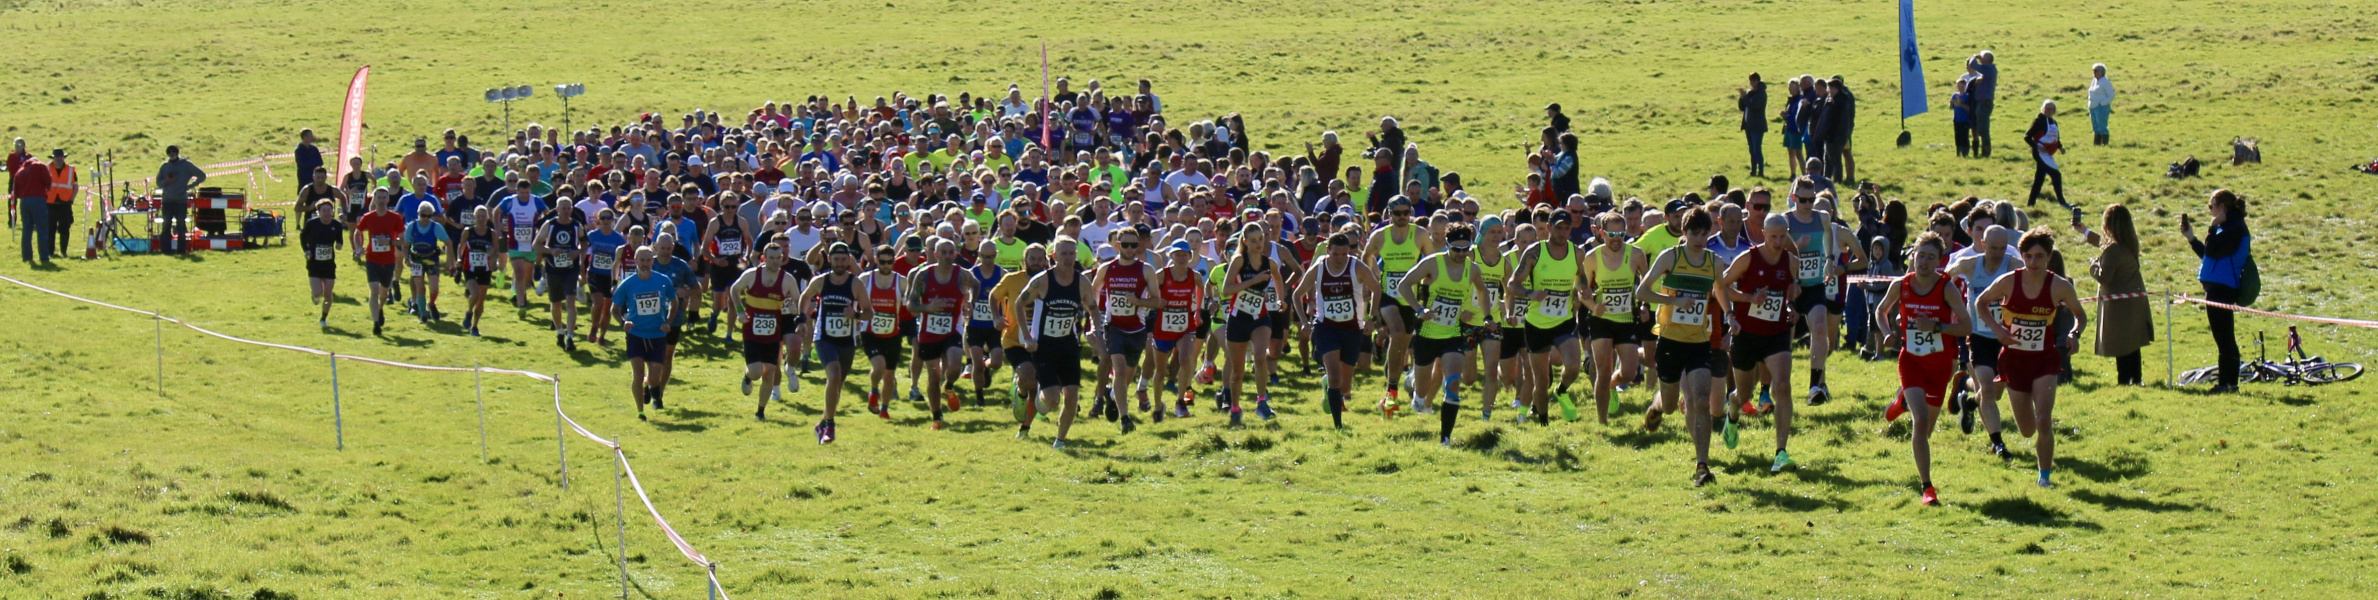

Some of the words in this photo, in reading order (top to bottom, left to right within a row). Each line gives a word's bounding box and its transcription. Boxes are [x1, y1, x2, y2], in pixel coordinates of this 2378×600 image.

[515, 228, 532, 237] 203
[723, 242, 740, 252] 292
[471, 253, 485, 262] 127
[595, 255, 612, 265] 256
[1799, 258, 1819, 271] 428
[638, 298, 660, 312] 197
[1045, 299, 1079, 308] LAUNCESTON
[1239, 292, 1263, 309] 448
[1544, 297, 1567, 309] 141
[1605, 294, 1630, 307] 297
[1326, 301, 1352, 314] 433
[1434, 304, 1459, 319] 413
[2031, 306, 2052, 314] ORC
[755, 319, 775, 330] 238
[828, 318, 850, 330] 104
[873, 317, 893, 329] 237
[930, 316, 951, 328] 142
[1048, 318, 1072, 330] 118
[1165, 314, 1187, 325] 123
[1914, 331, 1935, 346] 54
[2013, 327, 2043, 341] 432
